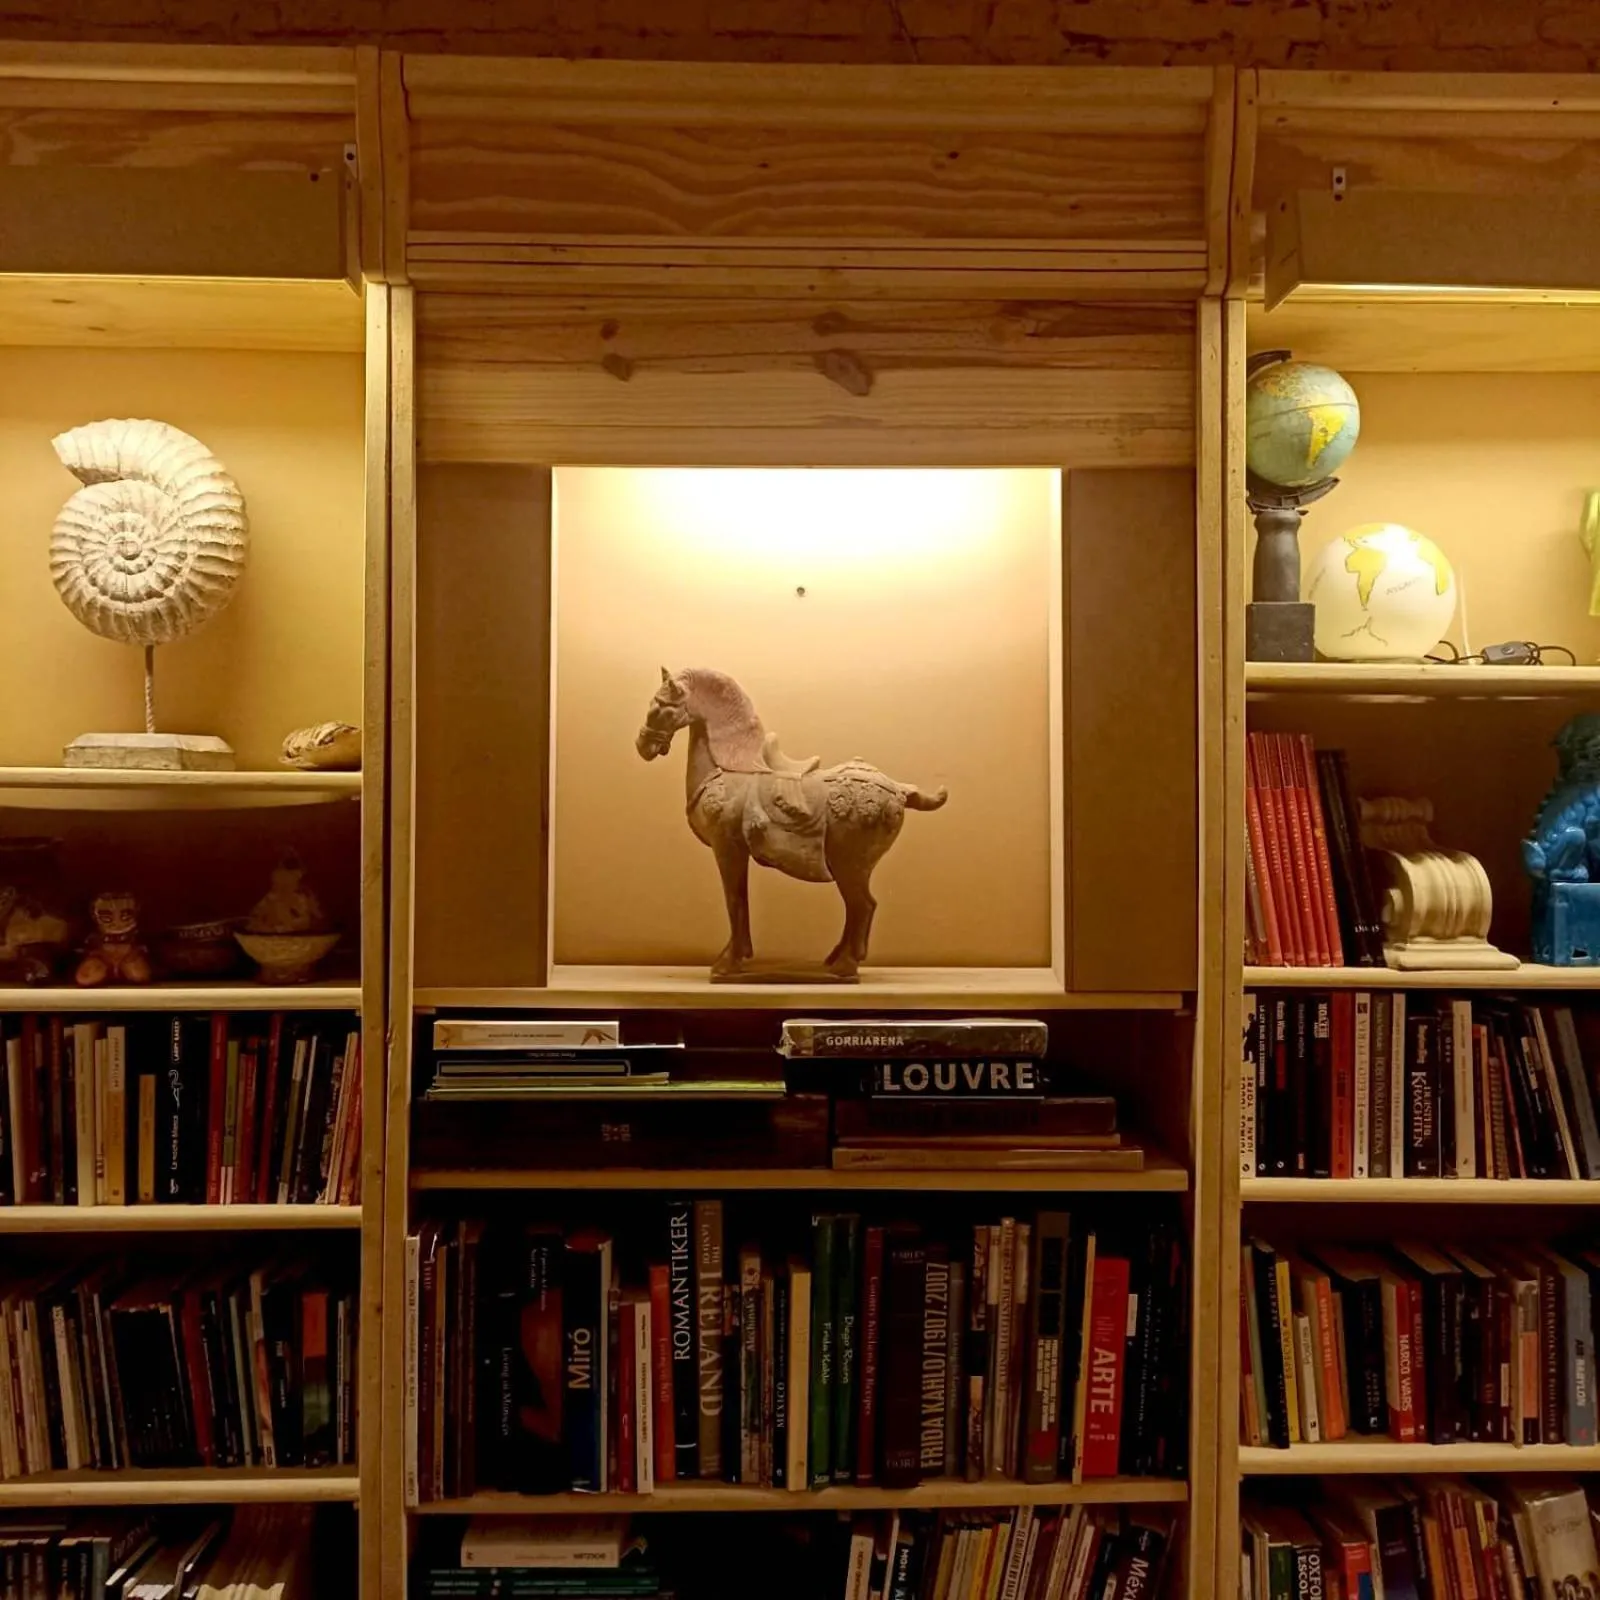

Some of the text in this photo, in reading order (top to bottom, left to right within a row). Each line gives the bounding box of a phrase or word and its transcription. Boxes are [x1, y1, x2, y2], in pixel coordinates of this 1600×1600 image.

[826, 1036, 905, 1046] GORRIARENA
[882, 1063, 1034, 1091] LOUVRE
[1411, 1071, 1427, 1148] KRACHTEN
[670, 1212, 692, 1361] ROMANTIKER
[500, 1346, 514, 1378] Living
[566, 1327, 592, 1390] Miró
[700, 1270, 723, 1418] IRELAND
[840, 1314, 854, 1348] Diego
[920, 1262, 949, 1468] FRIDA KAHLO/1907.2007
[1090, 1348, 1118, 1414] ARTE
[1399, 1334, 1412, 1412] NARCO WARS
[1576, 1358, 1586, 1407] BABYLON
[1297, 1555, 1308, 1600] ESCOL
